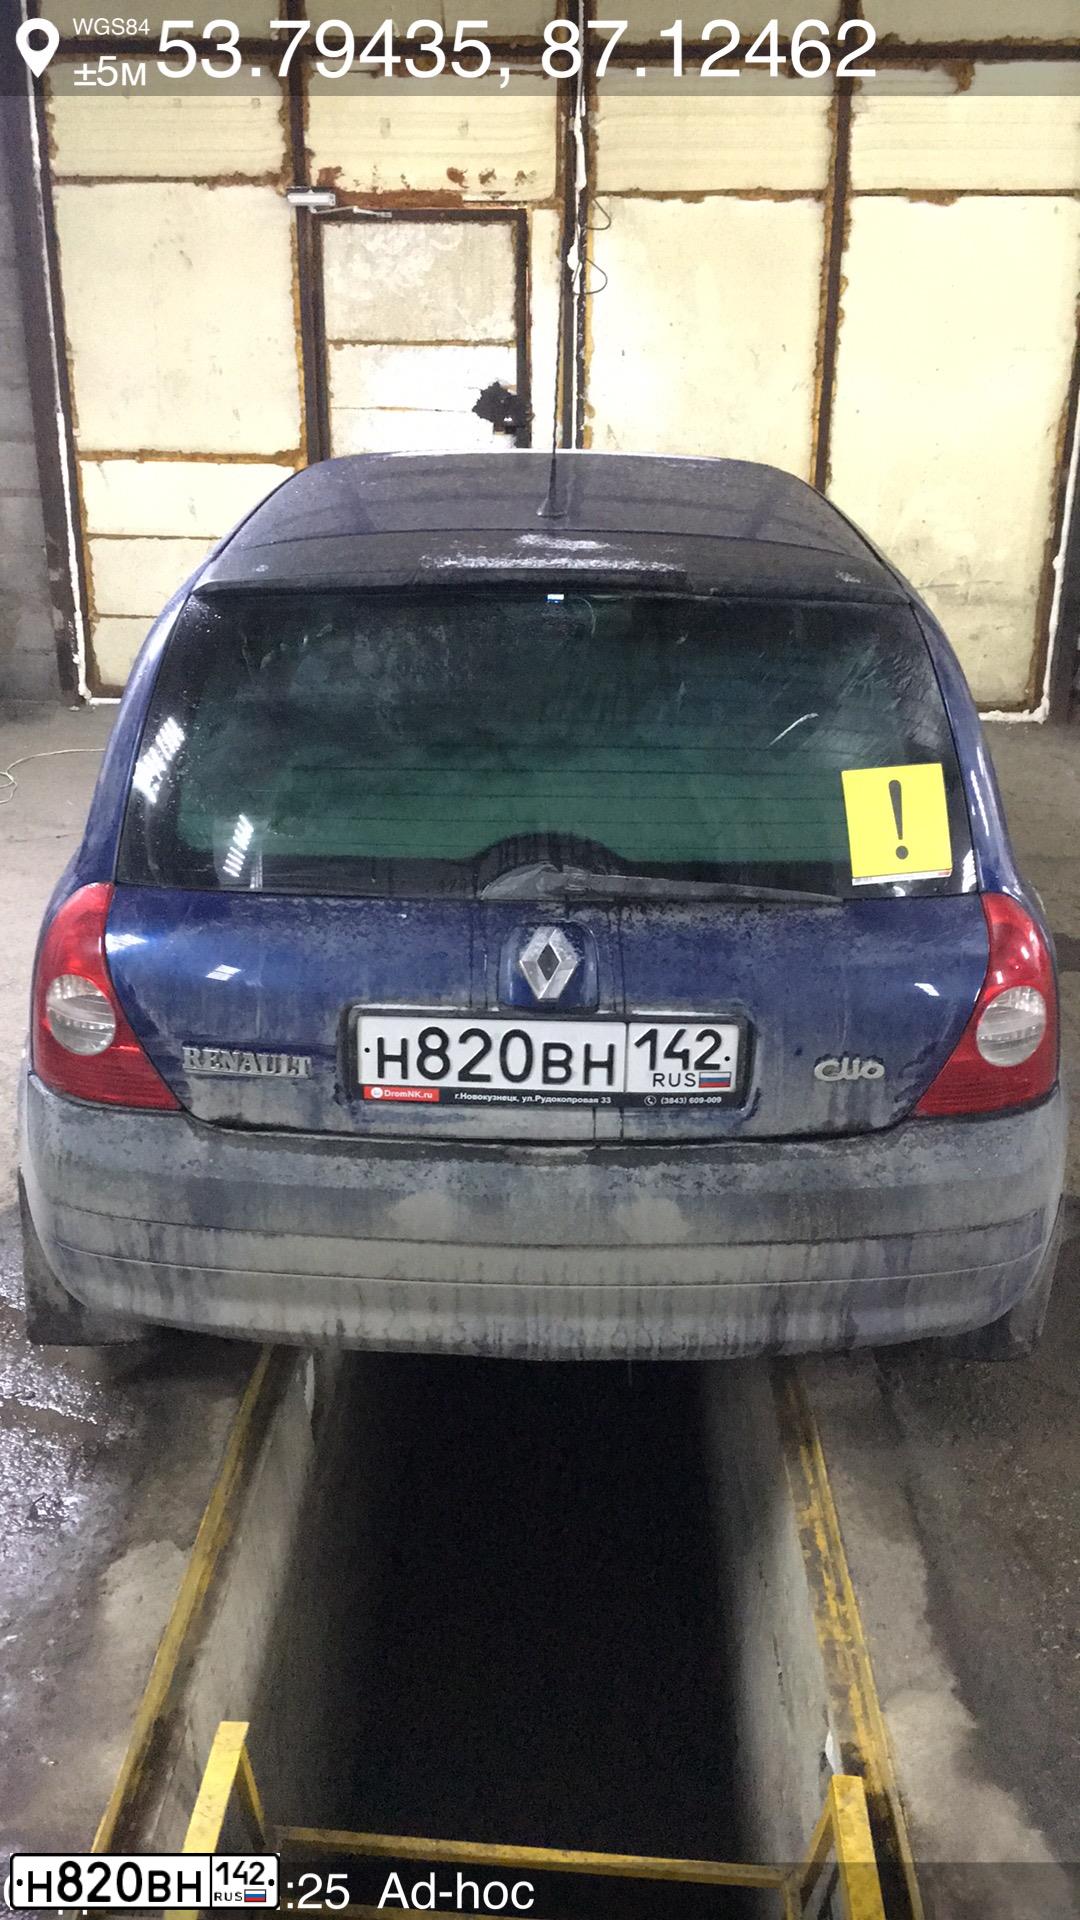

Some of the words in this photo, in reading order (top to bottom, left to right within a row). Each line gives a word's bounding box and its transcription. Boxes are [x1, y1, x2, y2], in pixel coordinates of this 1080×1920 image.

[634, 1028, 722, 1071] 142
[182, 1046, 312, 1078] RENAULT
[652, 1073, 697, 1088] RUS
[384, 1089, 433, 1100] DromNK.ru
[601, 1096, 612, 1104] 33
